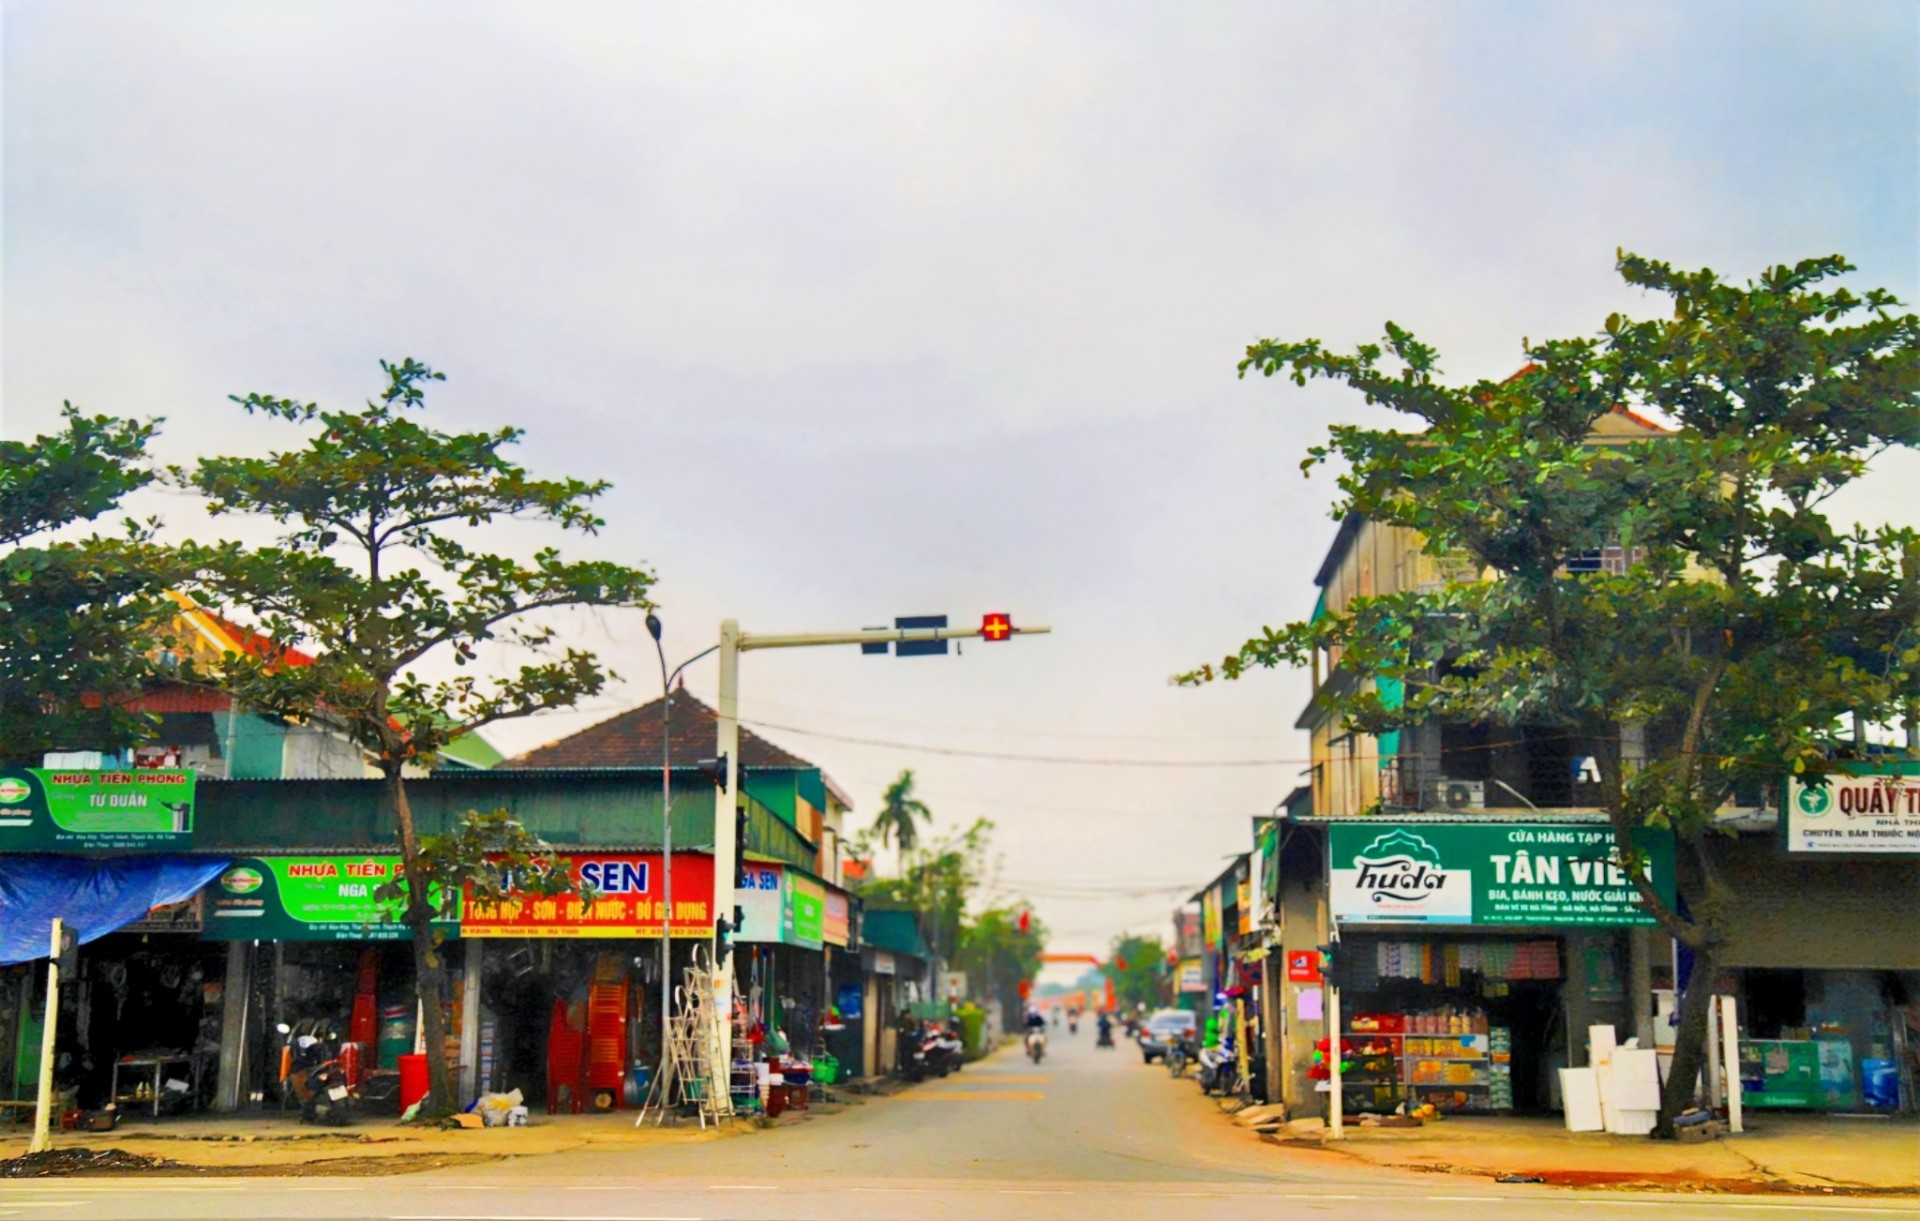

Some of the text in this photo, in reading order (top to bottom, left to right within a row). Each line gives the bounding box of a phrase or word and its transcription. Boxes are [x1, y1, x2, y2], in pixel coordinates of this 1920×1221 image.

[138, 774, 186, 784] PHONG
[1537, 830, 1575, 843] HÀNG
[1577, 832, 1603, 846] TẠP
[288, 860, 338, 880] NHỰA
[1355, 860, 1447, 889] huda
[1490, 849, 1559, 885] TÂN
[580, 860, 649, 894] SEN
[338, 884, 367, 897] NGA
[1512, 888, 1543, 900] BÁNH
[1571, 889, 1602, 902] NƯỚC
